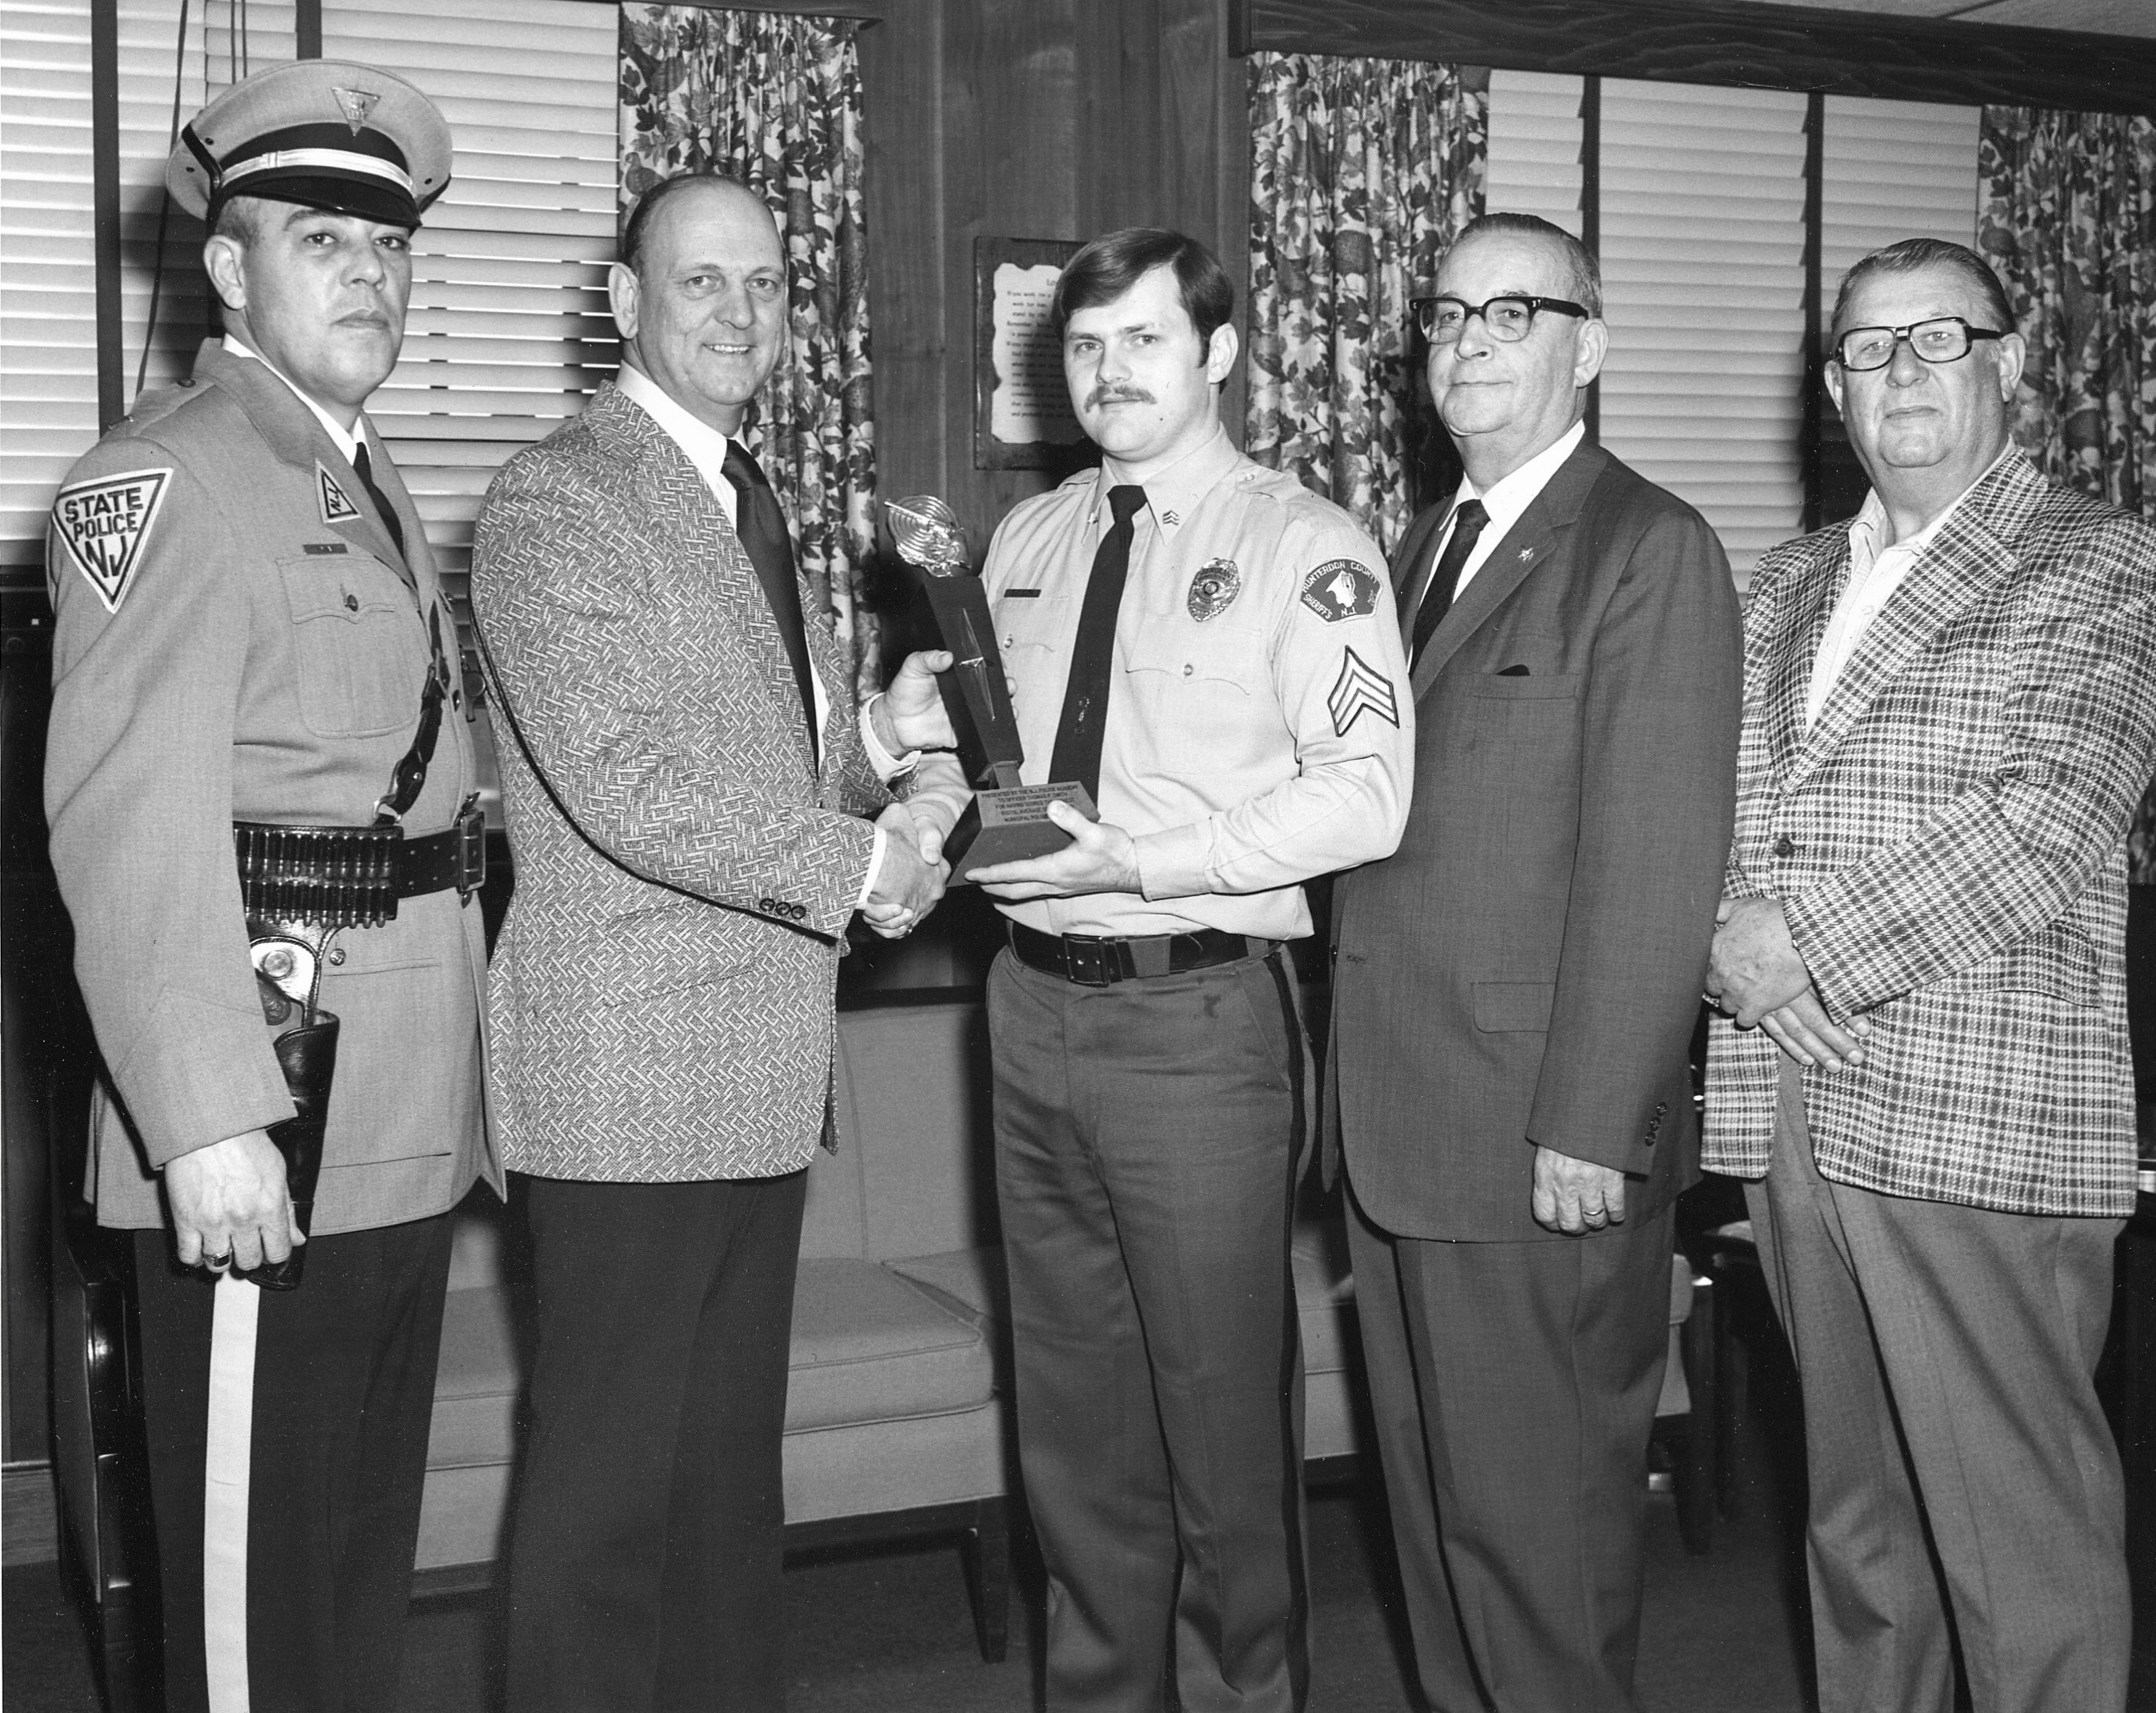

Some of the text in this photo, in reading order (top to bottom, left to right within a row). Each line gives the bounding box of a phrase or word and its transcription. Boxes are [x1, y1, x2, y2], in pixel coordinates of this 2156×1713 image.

[65, 486, 144, 523] STATE
[73, 512, 139, 542] POLICE
[85, 535, 127, 578] NJ
[1302, 561, 1379, 593] HUNTERDON COUNTY
